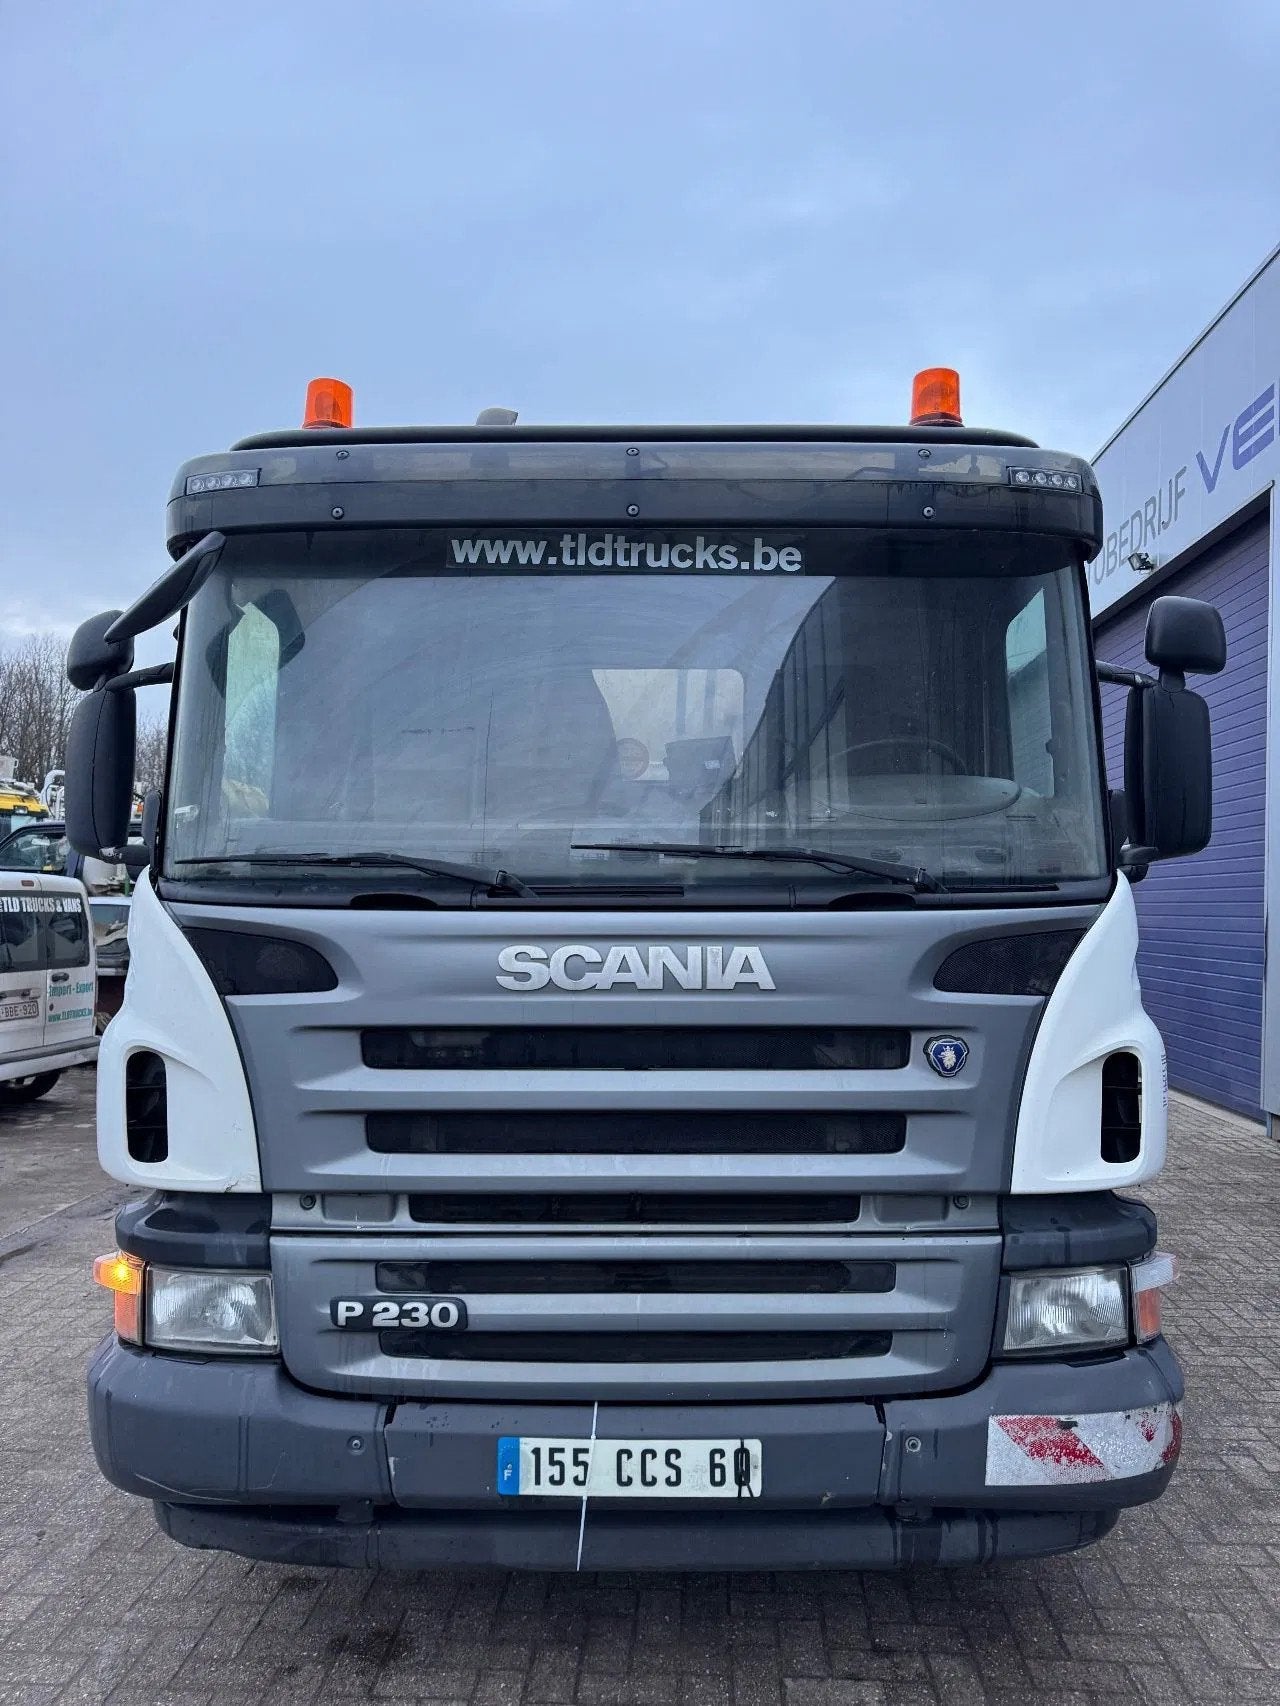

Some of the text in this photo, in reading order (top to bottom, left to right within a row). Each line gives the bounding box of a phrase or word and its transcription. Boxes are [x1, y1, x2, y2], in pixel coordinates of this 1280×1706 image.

[1196, 380, 1280, 494] VE
[451, 533, 802, 572] www.tldtrucks.be
[2, 897, 20, 912] TLD
[20, 897, 55, 912] TRUCKS
[56, 899, 63, 912] &
[63, 898, 82, 912] VANS
[495, 944, 776, 991] SCANIA
[337, 1301, 459, 1328] P 230
[531, 1447, 590, 1487] 155
[616, 1448, 682, 1487] CCS
[709, 1448, 751, 1487] 60
